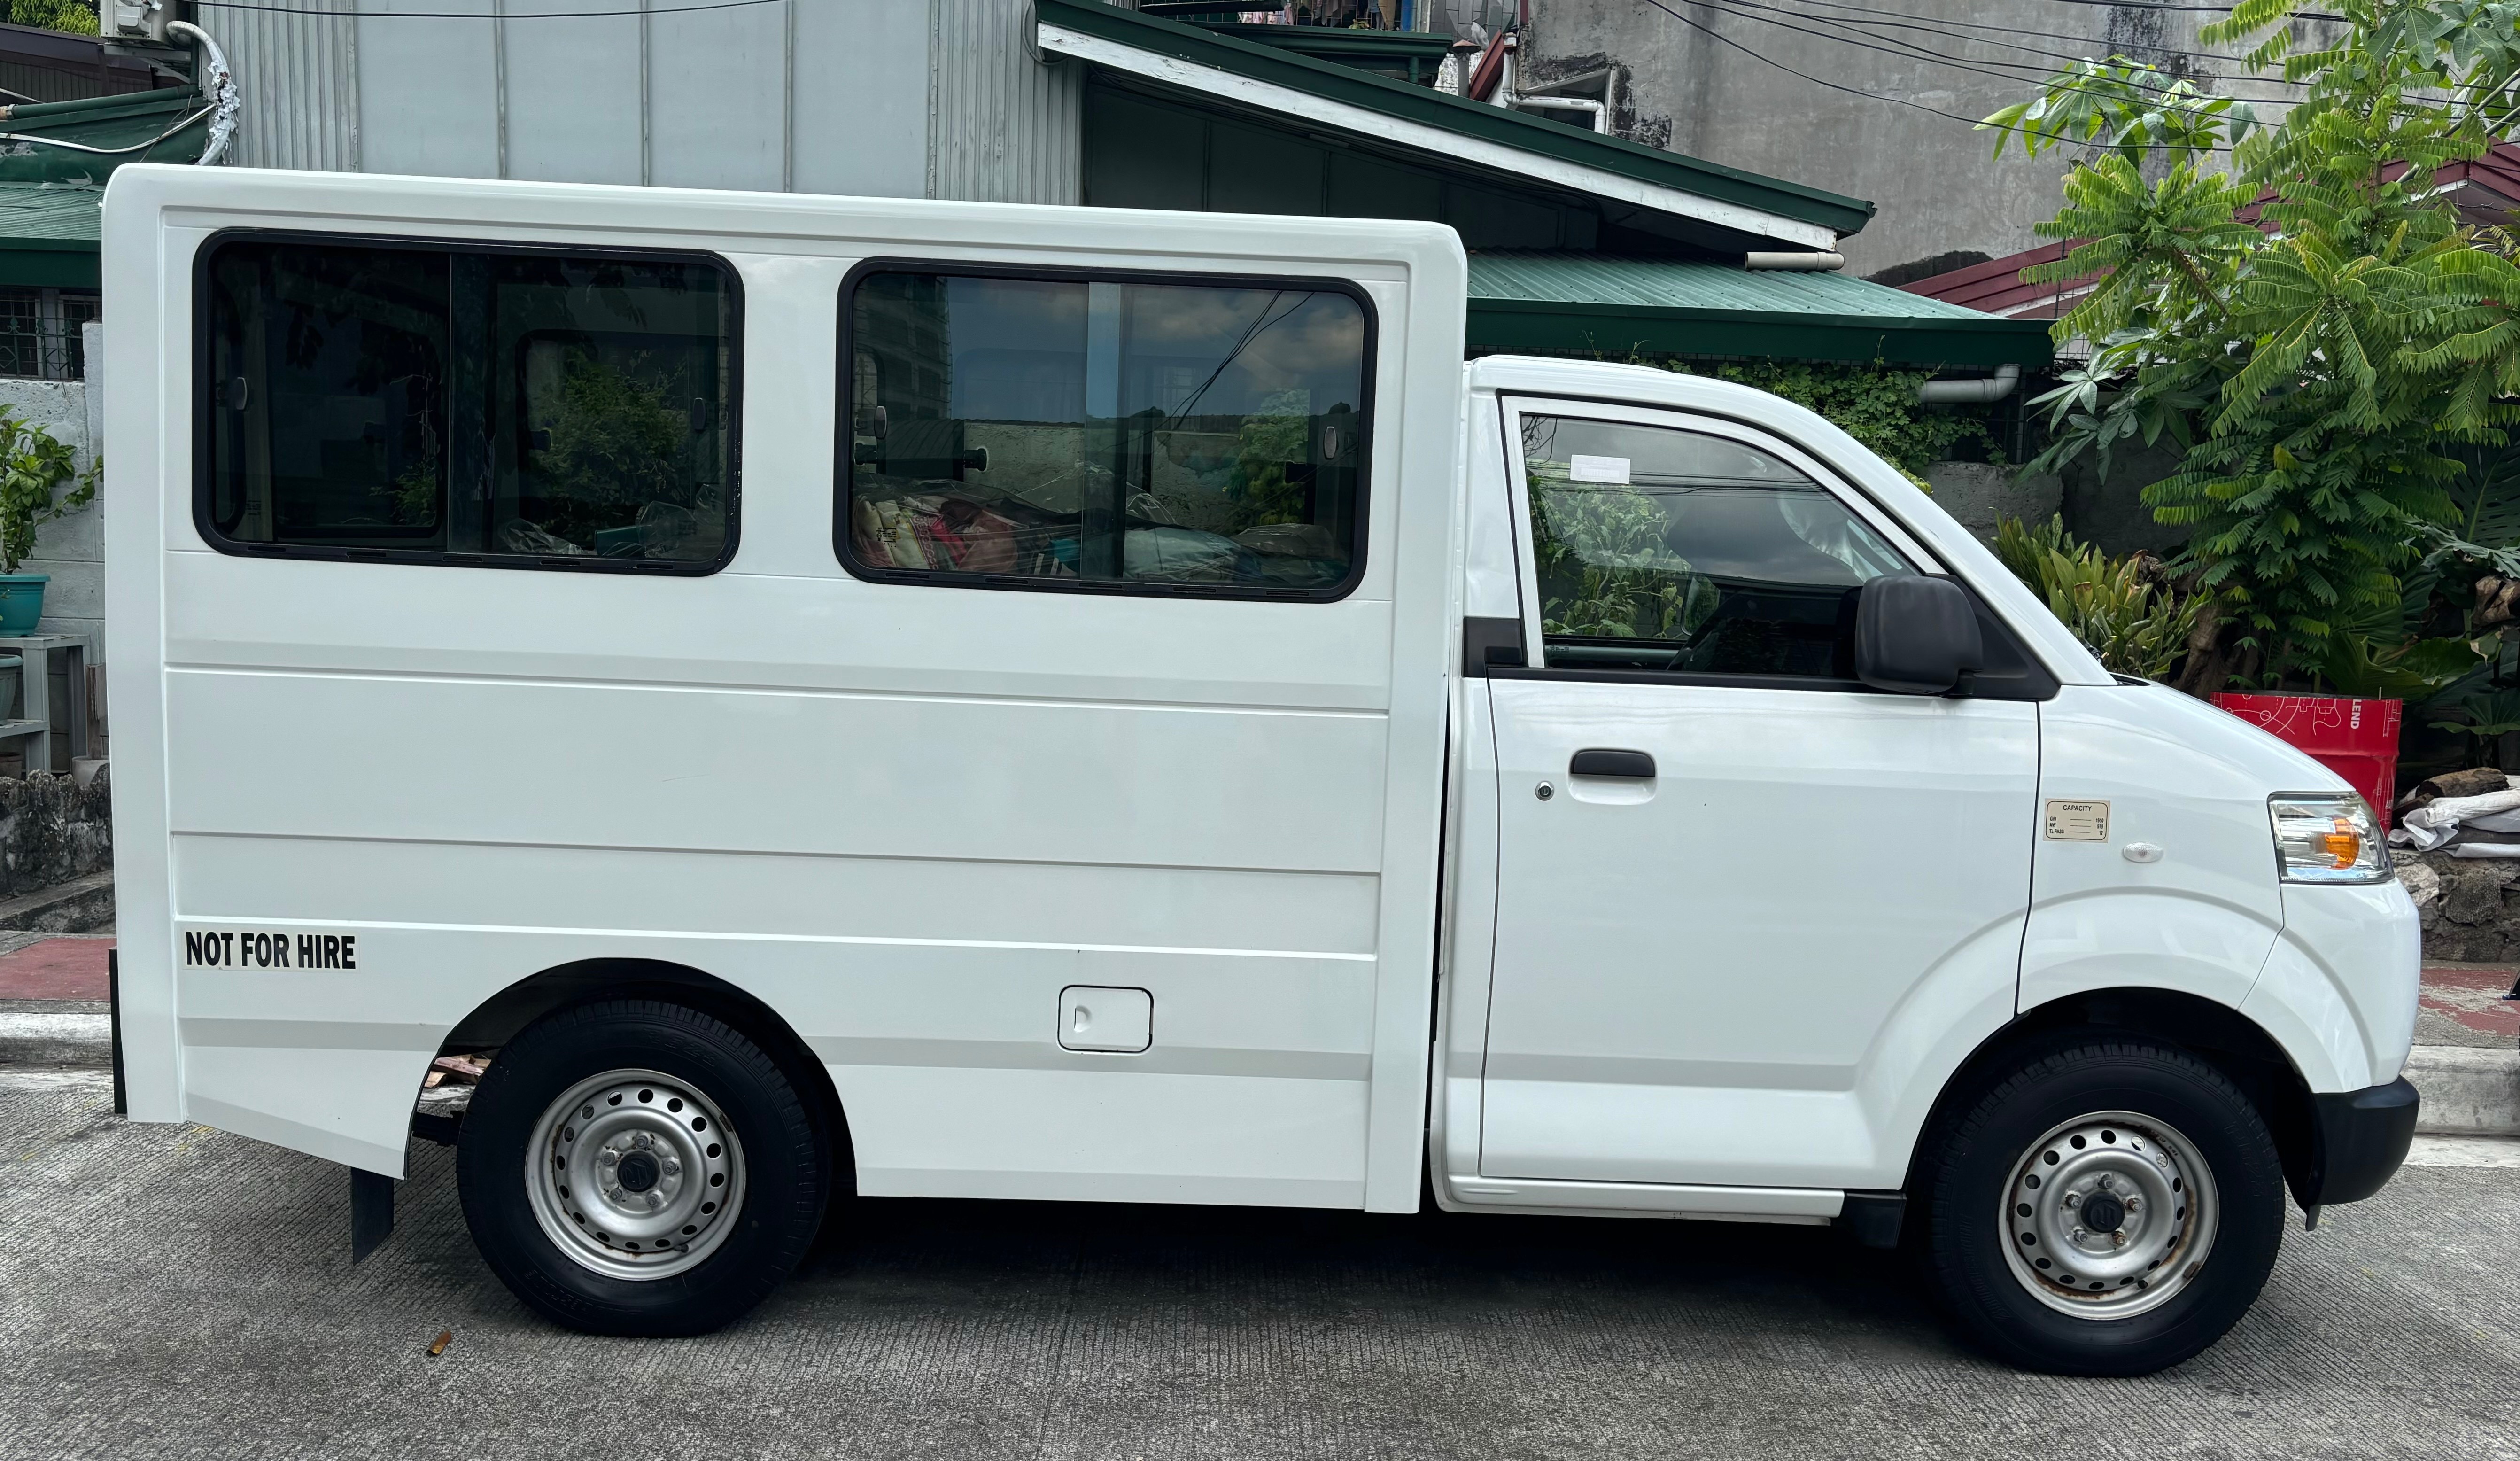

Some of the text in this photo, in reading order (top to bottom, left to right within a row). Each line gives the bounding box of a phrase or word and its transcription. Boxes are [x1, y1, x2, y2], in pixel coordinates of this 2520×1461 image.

[2350, 699, 2362, 730] LEND
[186, 932, 356, 969] NOT FOR HIRE
